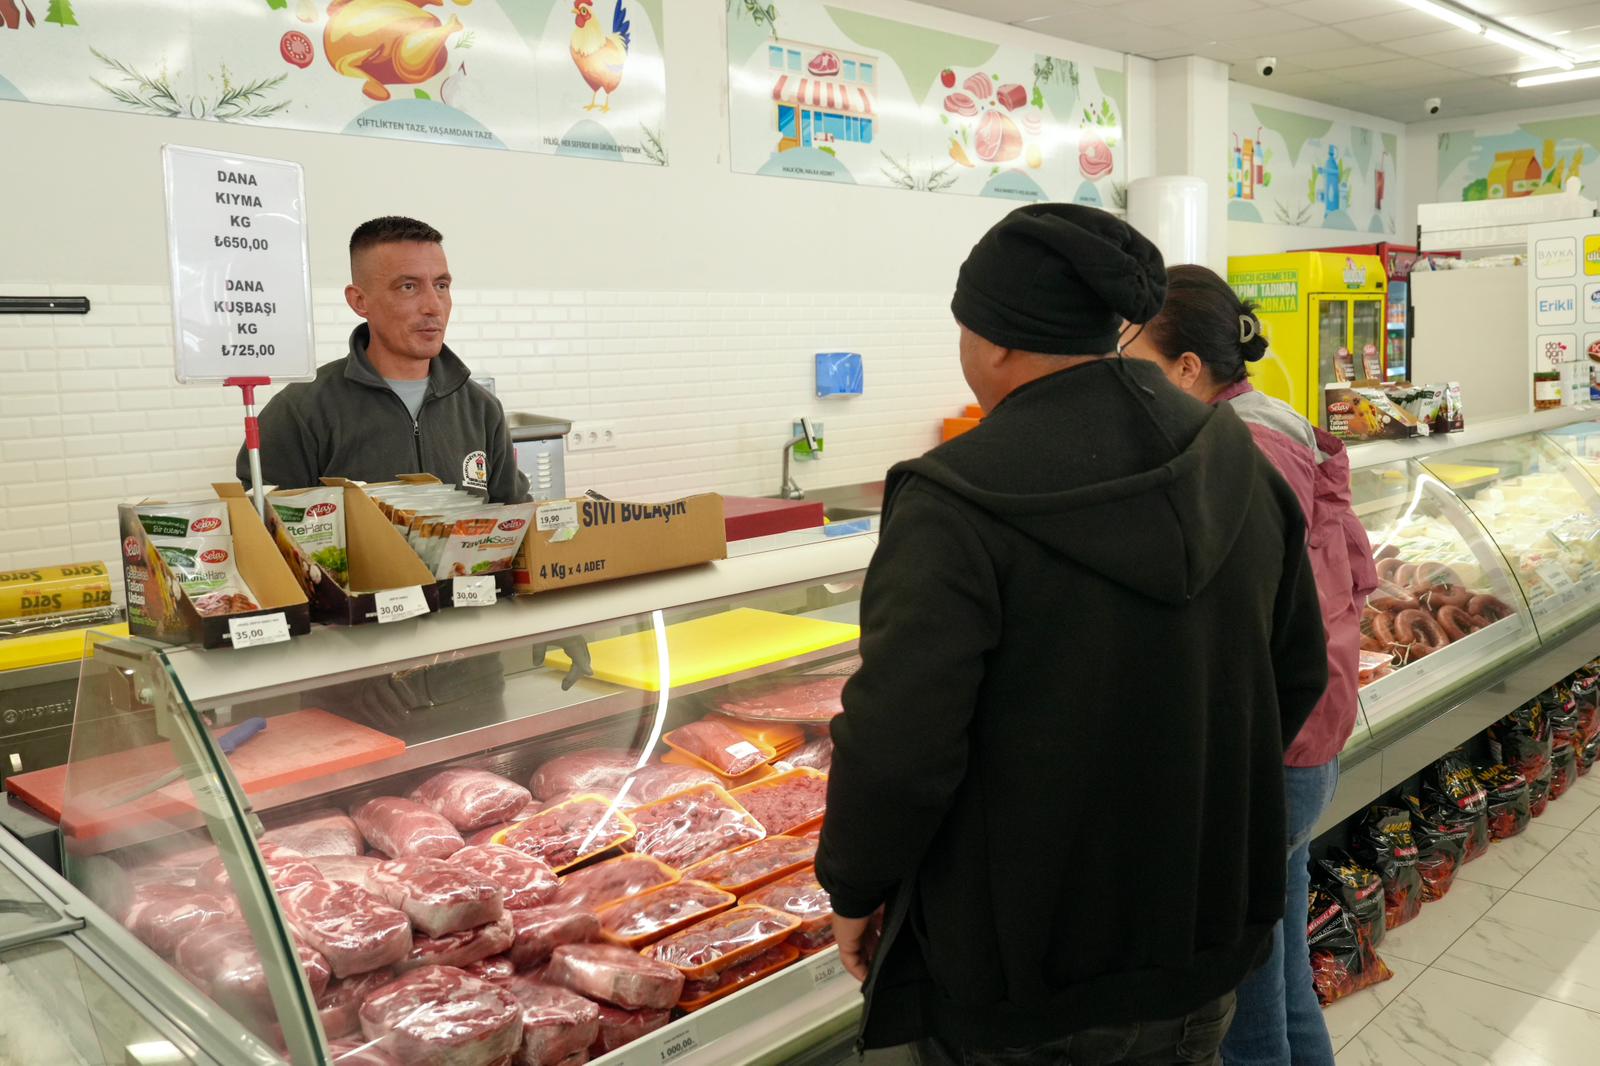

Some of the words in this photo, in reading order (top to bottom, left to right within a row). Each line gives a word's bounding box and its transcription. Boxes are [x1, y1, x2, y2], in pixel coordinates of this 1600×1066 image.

[357, 117, 404, 130] ÇİFTLİKTEN
[405, 122, 427, 134] TAZE,
[429, 123, 474, 138] YAŞAMDAN
[475, 131, 493, 140] TAZE
[217, 170, 258, 187] DANA
[215, 192, 263, 208] KIYMA
[230, 215, 251, 228] KG
[214, 235, 268, 252] ₺650,00
[225, 279, 264, 292] DANA
[214, 301, 276, 316] KUŞBAŞI
[1539, 299, 1574, 313] Erikli
[237, 323, 258, 335] KG
[221, 344, 275, 358] ₺725,00
[540, 515, 560, 524] 19,90
[583, 502, 615, 527] SIVI
[540, 565, 547, 579] 4
[551, 563, 566, 579] Kg
[576, 563, 582, 573] 4
[584, 560, 605, 573] ADET
[21, 593, 62, 610] Sera
[456, 592, 478, 600] 30,00
[380, 604, 404, 616] 30,00
[235, 629, 264, 640] 35,00
